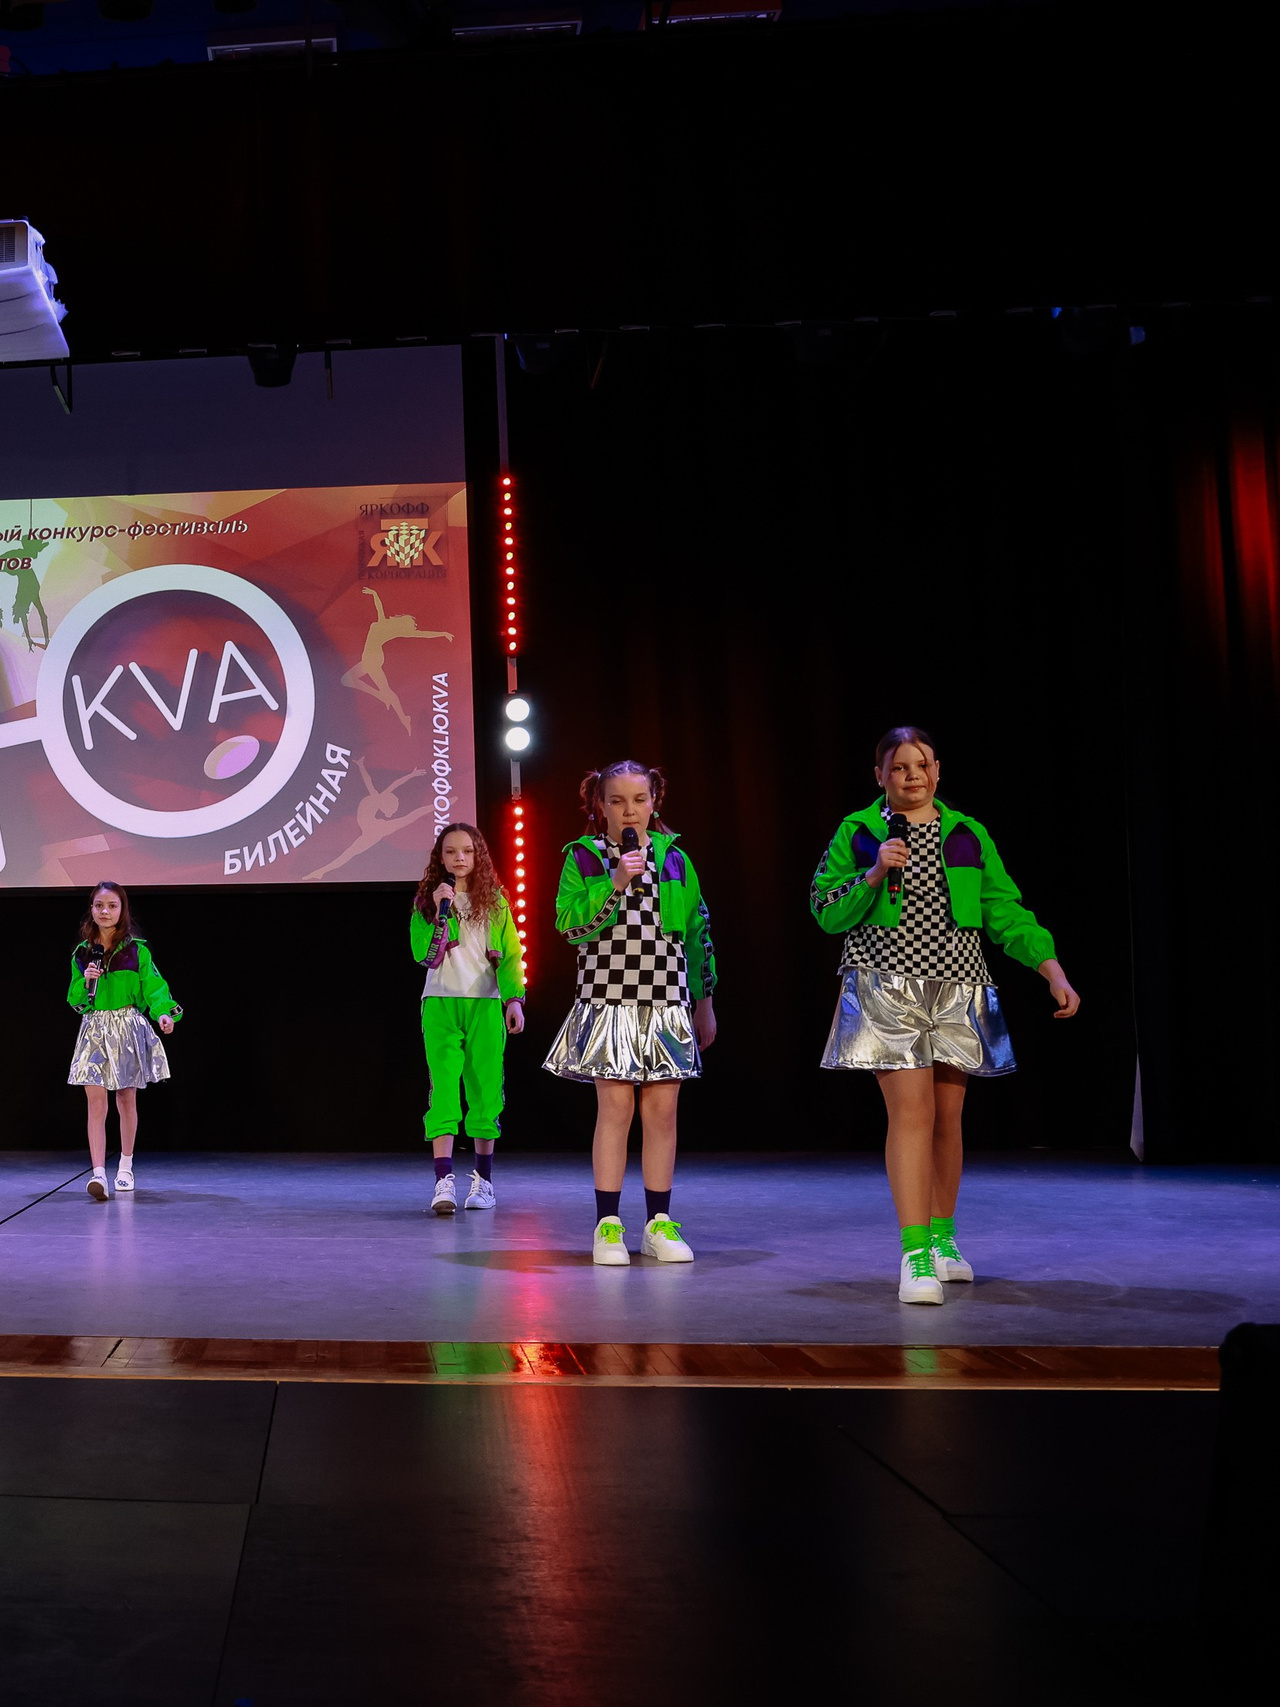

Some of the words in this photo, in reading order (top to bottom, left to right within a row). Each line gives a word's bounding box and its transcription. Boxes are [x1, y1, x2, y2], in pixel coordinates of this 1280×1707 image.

[359, 502, 430, 516] ЯРКОФФ
[27, 520, 248, 543] конкурс-фестиваль
[223, 742, 352, 876] БИЛЕЙНАЯ
